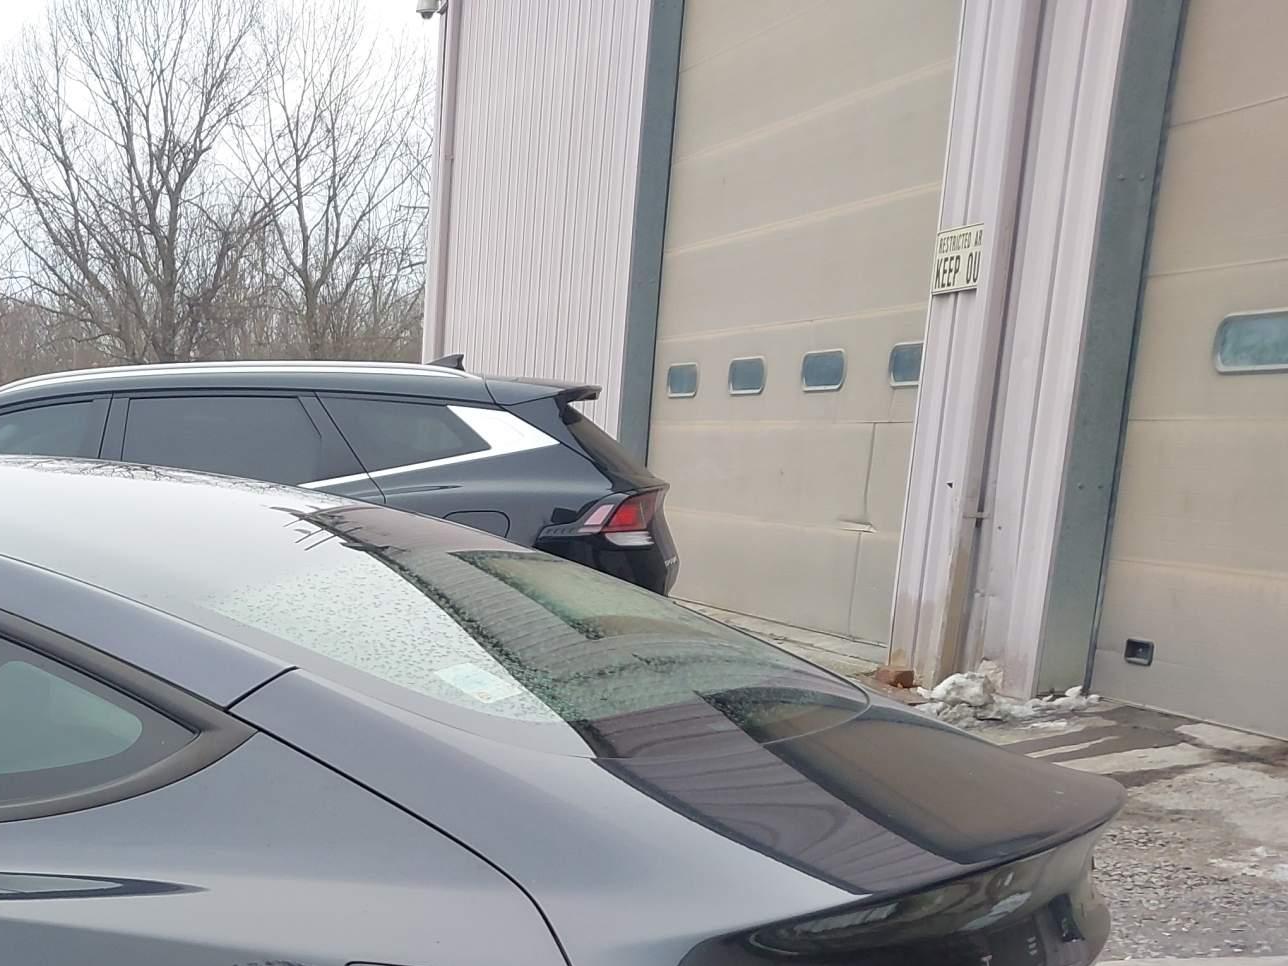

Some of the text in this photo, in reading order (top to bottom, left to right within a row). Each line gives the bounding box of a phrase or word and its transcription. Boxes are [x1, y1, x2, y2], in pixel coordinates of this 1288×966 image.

[939, 229, 983, 254] RESTRICTED AR
[934, 251, 981, 290] KEEP OU
